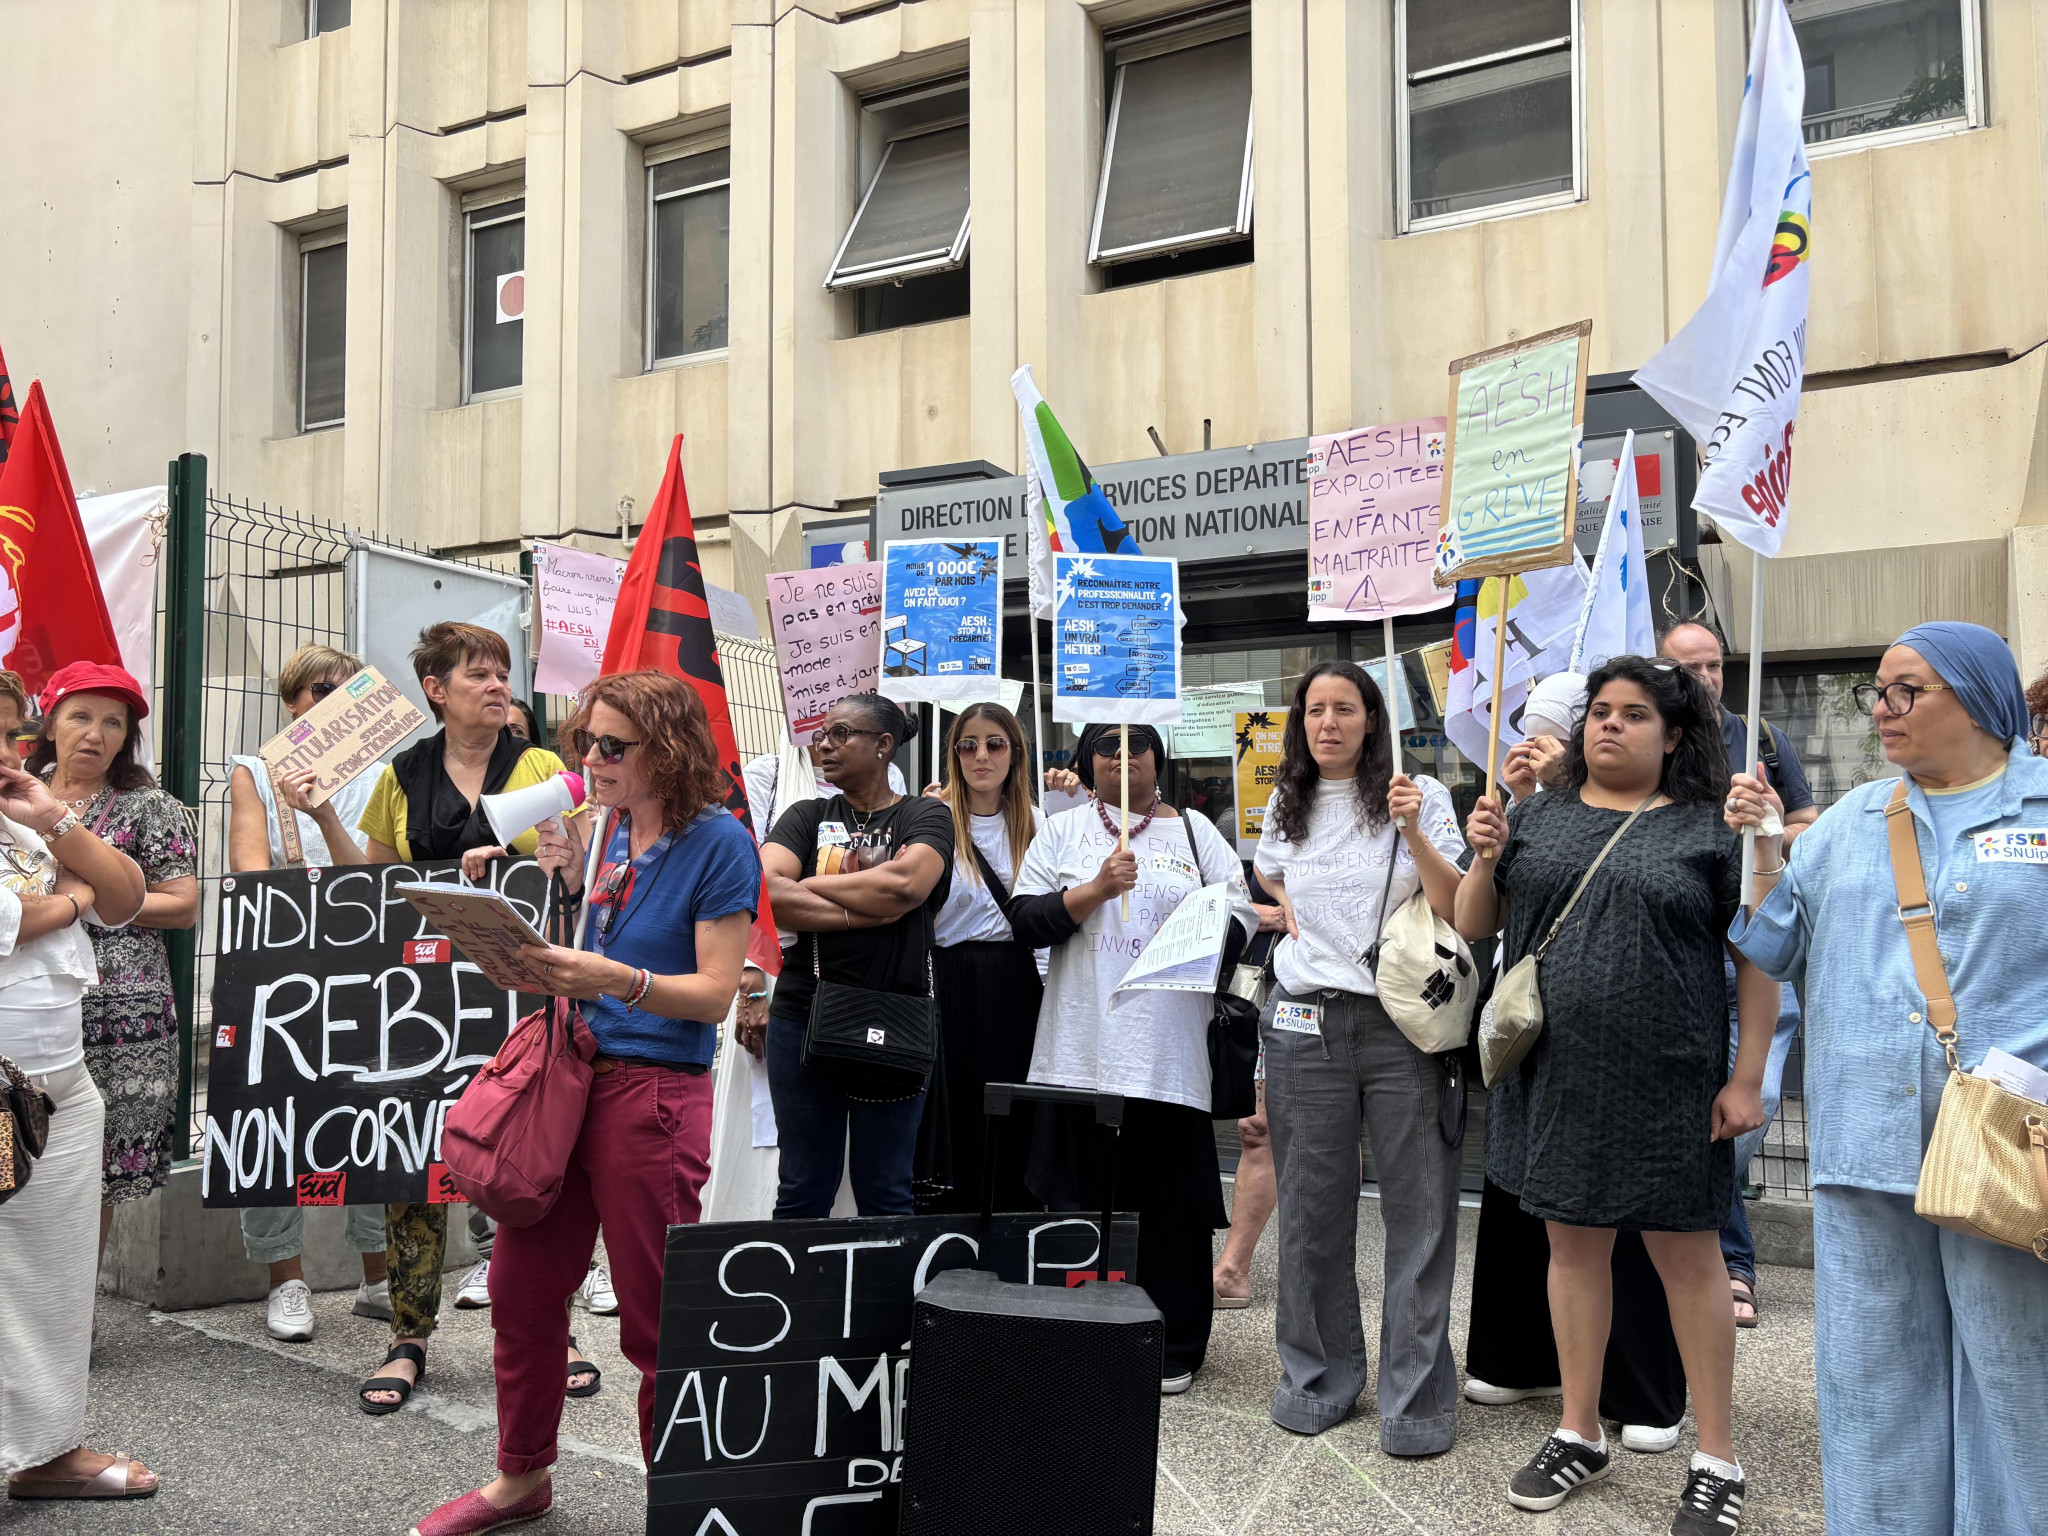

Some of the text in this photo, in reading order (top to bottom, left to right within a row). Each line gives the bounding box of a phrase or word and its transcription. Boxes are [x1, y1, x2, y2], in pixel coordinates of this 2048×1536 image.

[1465, 363, 1570, 437] AESH
[1326, 426, 1421, 466] AESH
[1491, 449, 1534, 471] en
[1099, 474, 1187, 507] RVICES
[1457, 473, 1560, 532] GRÈVE
[1577, 506, 1604, 518] galité
[901, 498, 1012, 532] DIRECTION
[1185, 500, 1310, 538] NATIONAL
[906, 562, 925, 570] MOINS
[774, 571, 878, 604] Je ne suis
[935, 576, 976, 586] PAR MOIS
[1078, 579, 1160, 589] RECONNAÎTRE NOTRE
[543, 581, 571, 596] faire
[595, 592, 618, 606] journ
[904, 588, 927, 597] AVEC
[904, 597, 917, 607] ON
[917, 597, 937, 607] FAIT
[938, 597, 959, 607] QUOI
[782, 592, 881, 631] pas en grèv
[1078, 600, 1099, 609] C'EST
[1101, 601, 1121, 609] TROP
[1122, 602, 1161, 610] DEMANDER
[544, 619, 594, 635] #AESH
[957, 627, 975, 635] STOP
[961, 616, 987, 626] AESH
[1064, 619, 1094, 632] AESH
[584, 638, 599, 646] EN
[788, 620, 880, 659] Je suis en
[1064, 633, 1100, 643] UN VRAI
[274, 680, 402, 771] TITULARISATION
[359, 709, 398, 743] STATUT
[333, 708, 423, 780] FONCTIONNAIRE
[1255, 732, 1279, 741] ON NE
[1148, 838, 1177, 857] EN
[2003, 847, 2048, 861] SNUip
[1327, 878, 1364, 898] PAS
[1286, 1018, 1316, 1032] SNUipp
[202, 1096, 295, 1198] NON
[299, 1173, 344, 1199] Sud
[654, 1370, 772, 1463] AU
